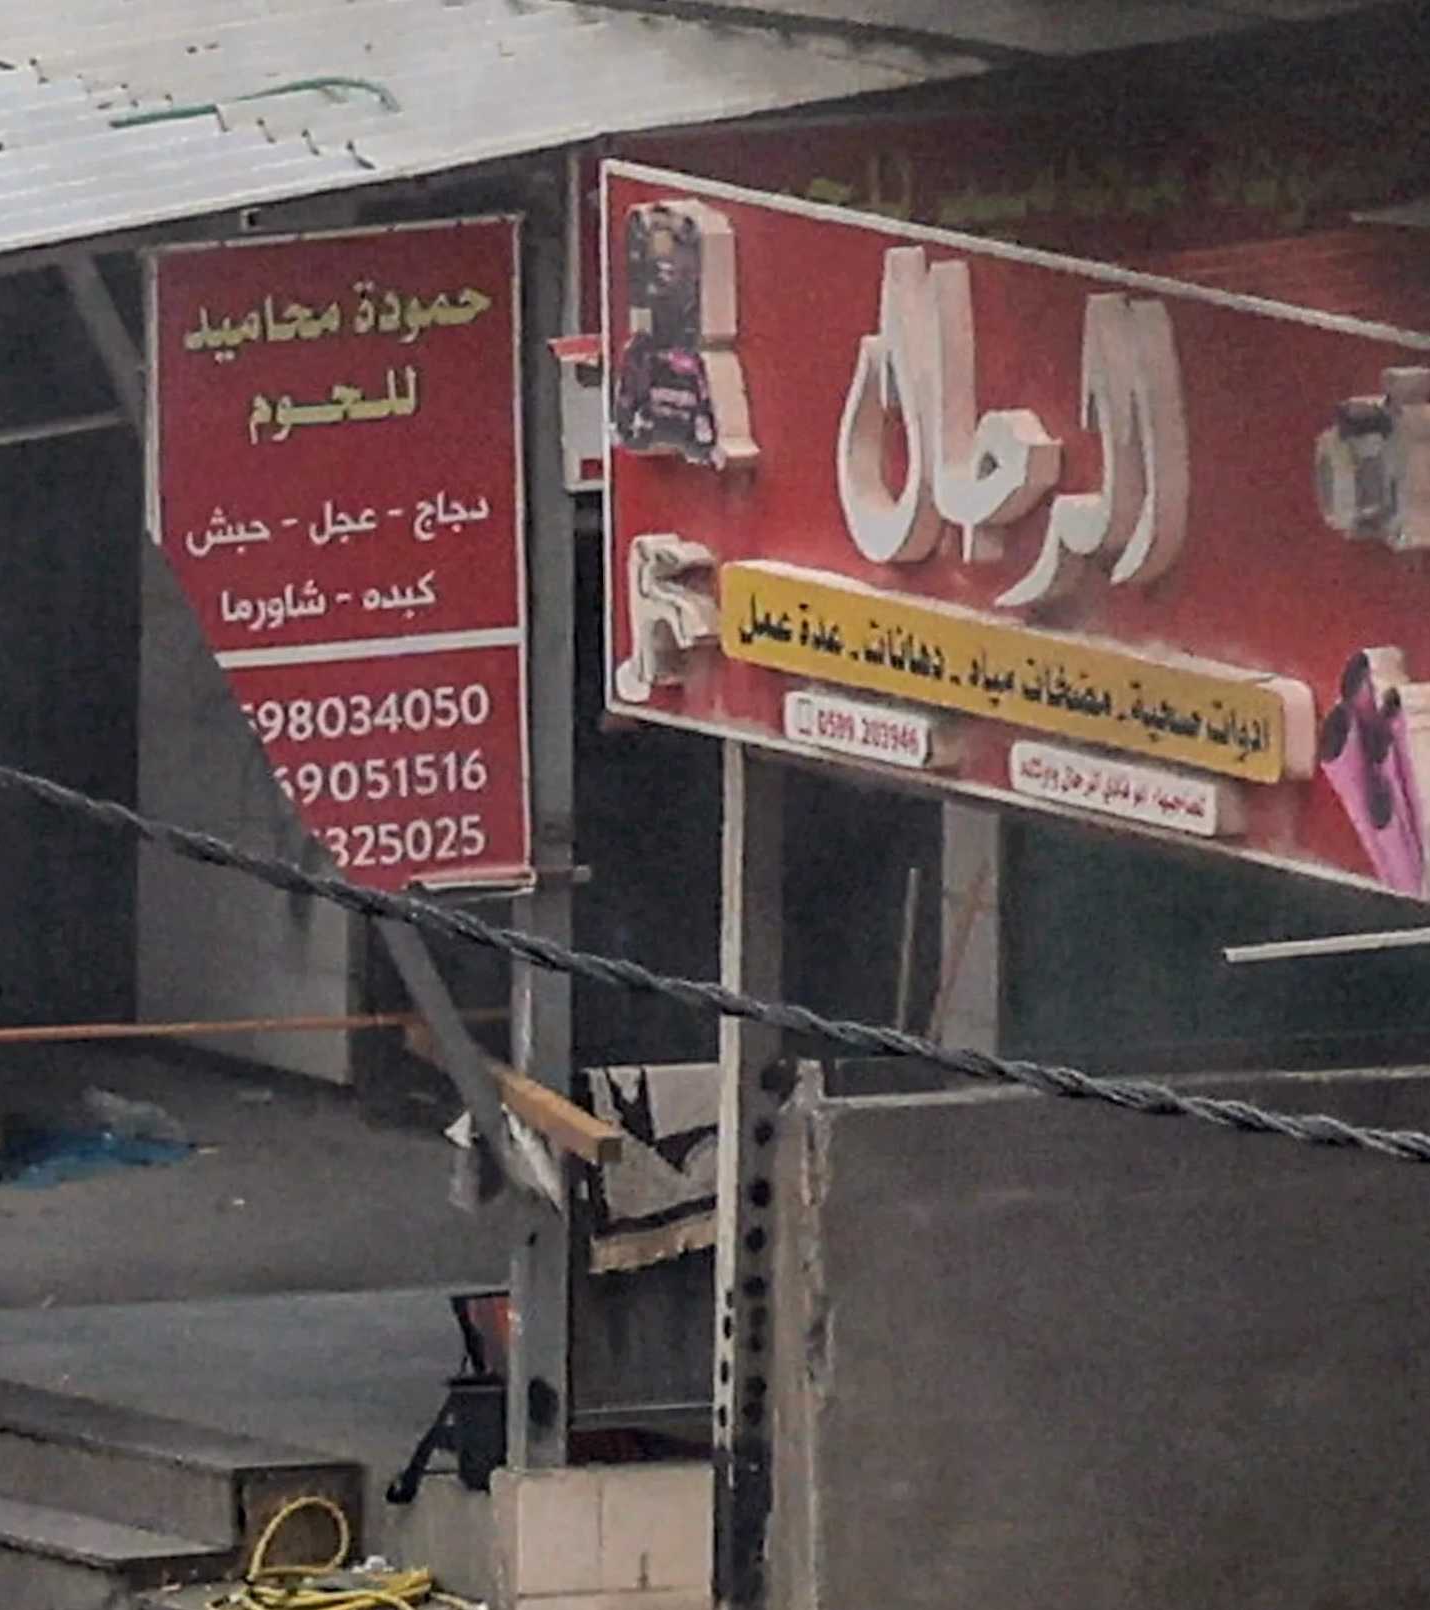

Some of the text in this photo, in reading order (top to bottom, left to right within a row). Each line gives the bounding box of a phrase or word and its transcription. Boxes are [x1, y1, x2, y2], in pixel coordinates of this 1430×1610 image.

[184, 279, 492, 363] حمودة محاميد
[248, 365, 417, 445] للحوم
[185, 505, 271, 556] حبش
[309, 500, 377, 545] عجل
[413, 490, 490, 541] دجاج
[220, 579, 326, 631] شاورما
[362, 569, 437, 619] كبده
[739, 592, 792, 645] عمل
[799, 602, 844, 655] عدة
[969, 651, 1015, 707] مياه
[1131, 680, 1201, 742] صحية
[1206, 699, 1270, 763] ادوات
